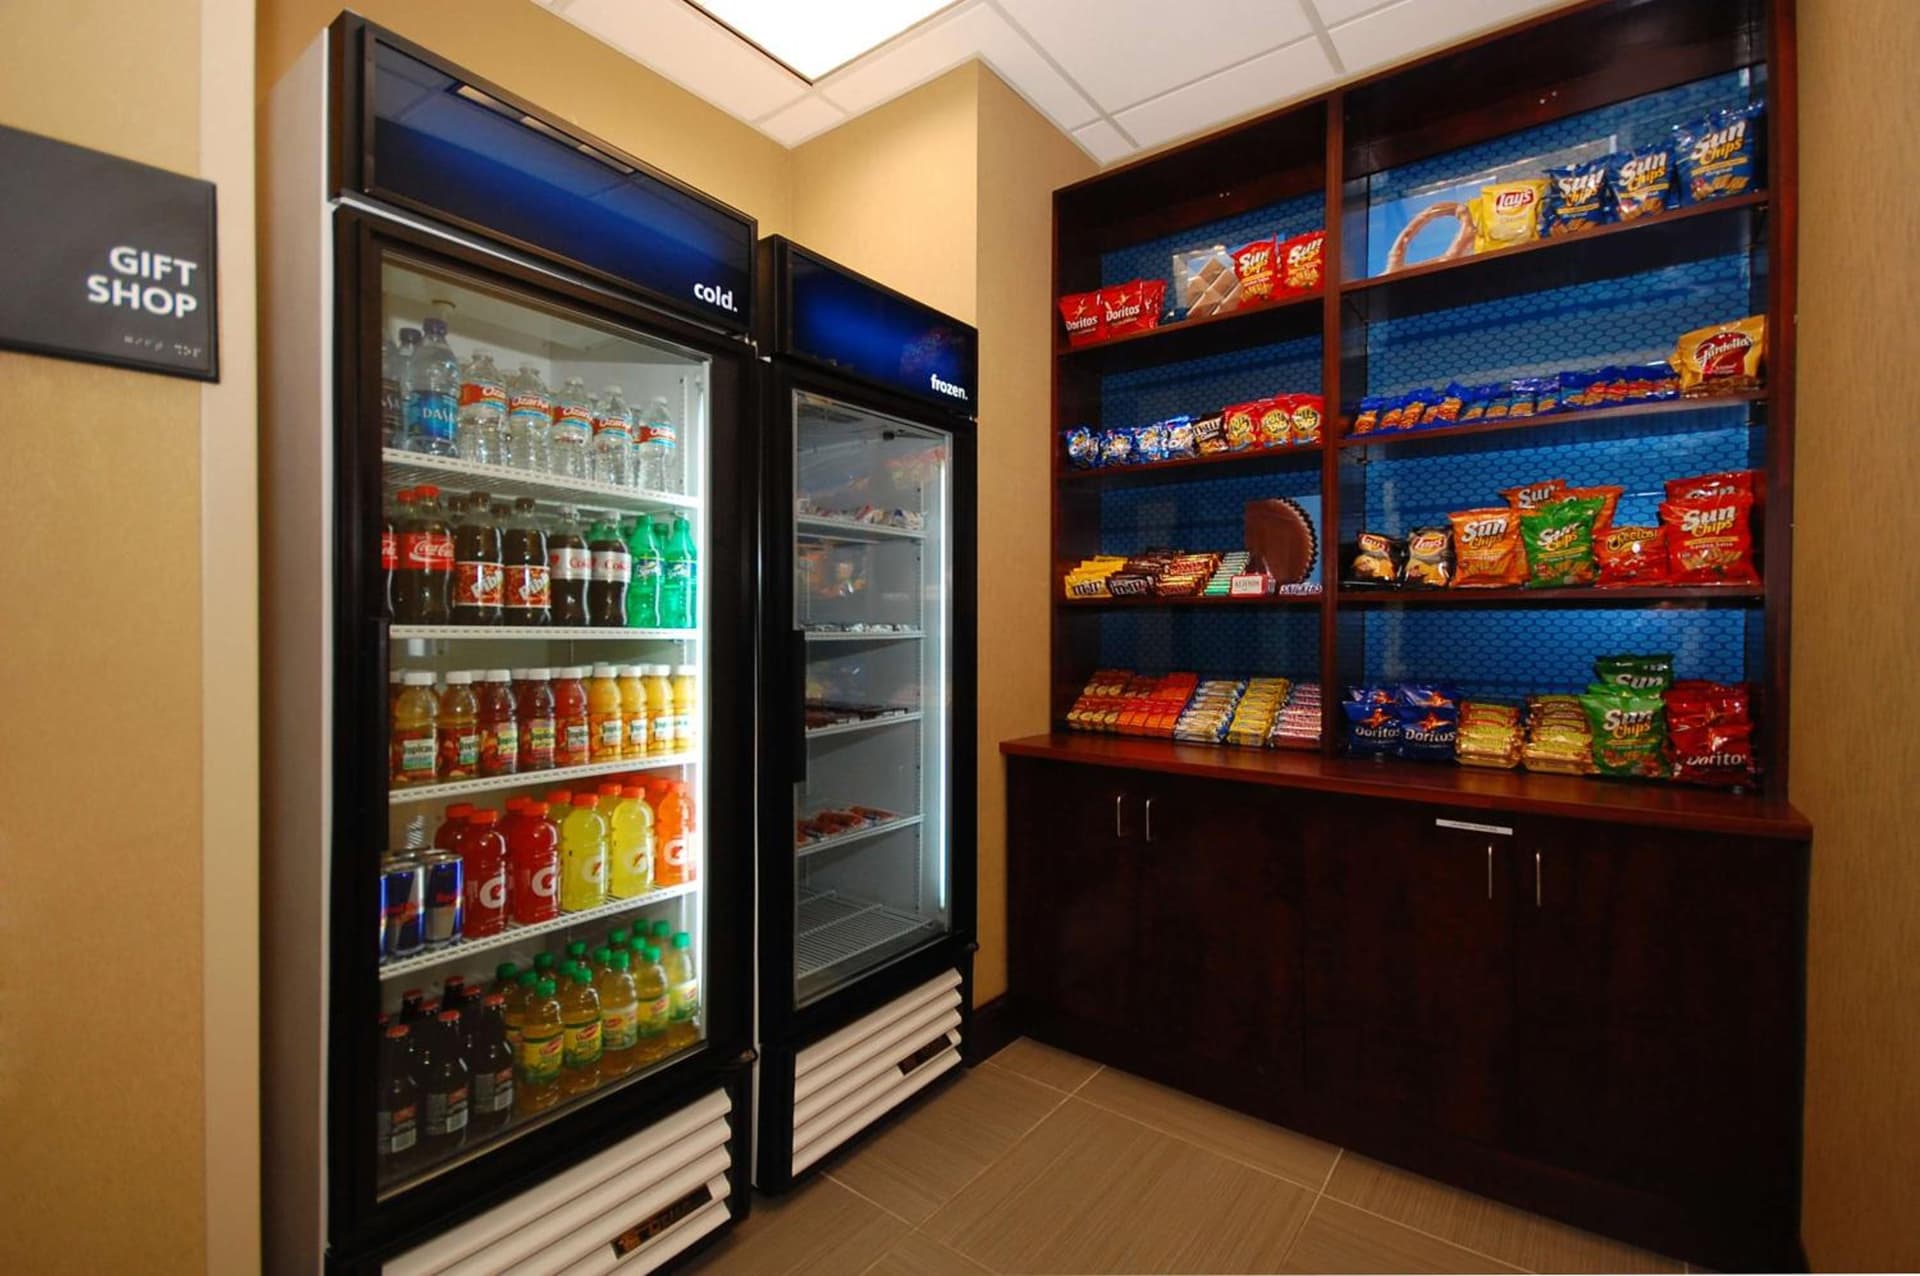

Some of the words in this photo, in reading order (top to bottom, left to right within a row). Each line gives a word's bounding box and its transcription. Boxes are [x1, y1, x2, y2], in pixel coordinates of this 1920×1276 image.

[1691, 121, 1746, 161] Sun
[1700, 138, 1744, 165] Chips
[1619, 152, 1668, 185] Sun
[1628, 166, 1666, 192] Chips
[1239, 248, 1271, 272] Sun
[1286, 238, 1324, 264] Sun
[109, 246, 198, 287] GIFT
[87, 274, 197, 318] SHOP
[693, 283, 738, 313] cold.
[1065, 315, 1099, 332] Doritos
[1106, 304, 1141, 322] Doritos
[930, 373, 969, 400] frozen.
[1461, 519, 1507, 543] Sun
[1681, 506, 1736, 532] Sun
[1691, 520, 1733, 537] Chips
[1603, 708, 1654, 732] Sun
[1612, 722, 1651, 739] Chips
[1404, 728, 1457, 743] Doritos
